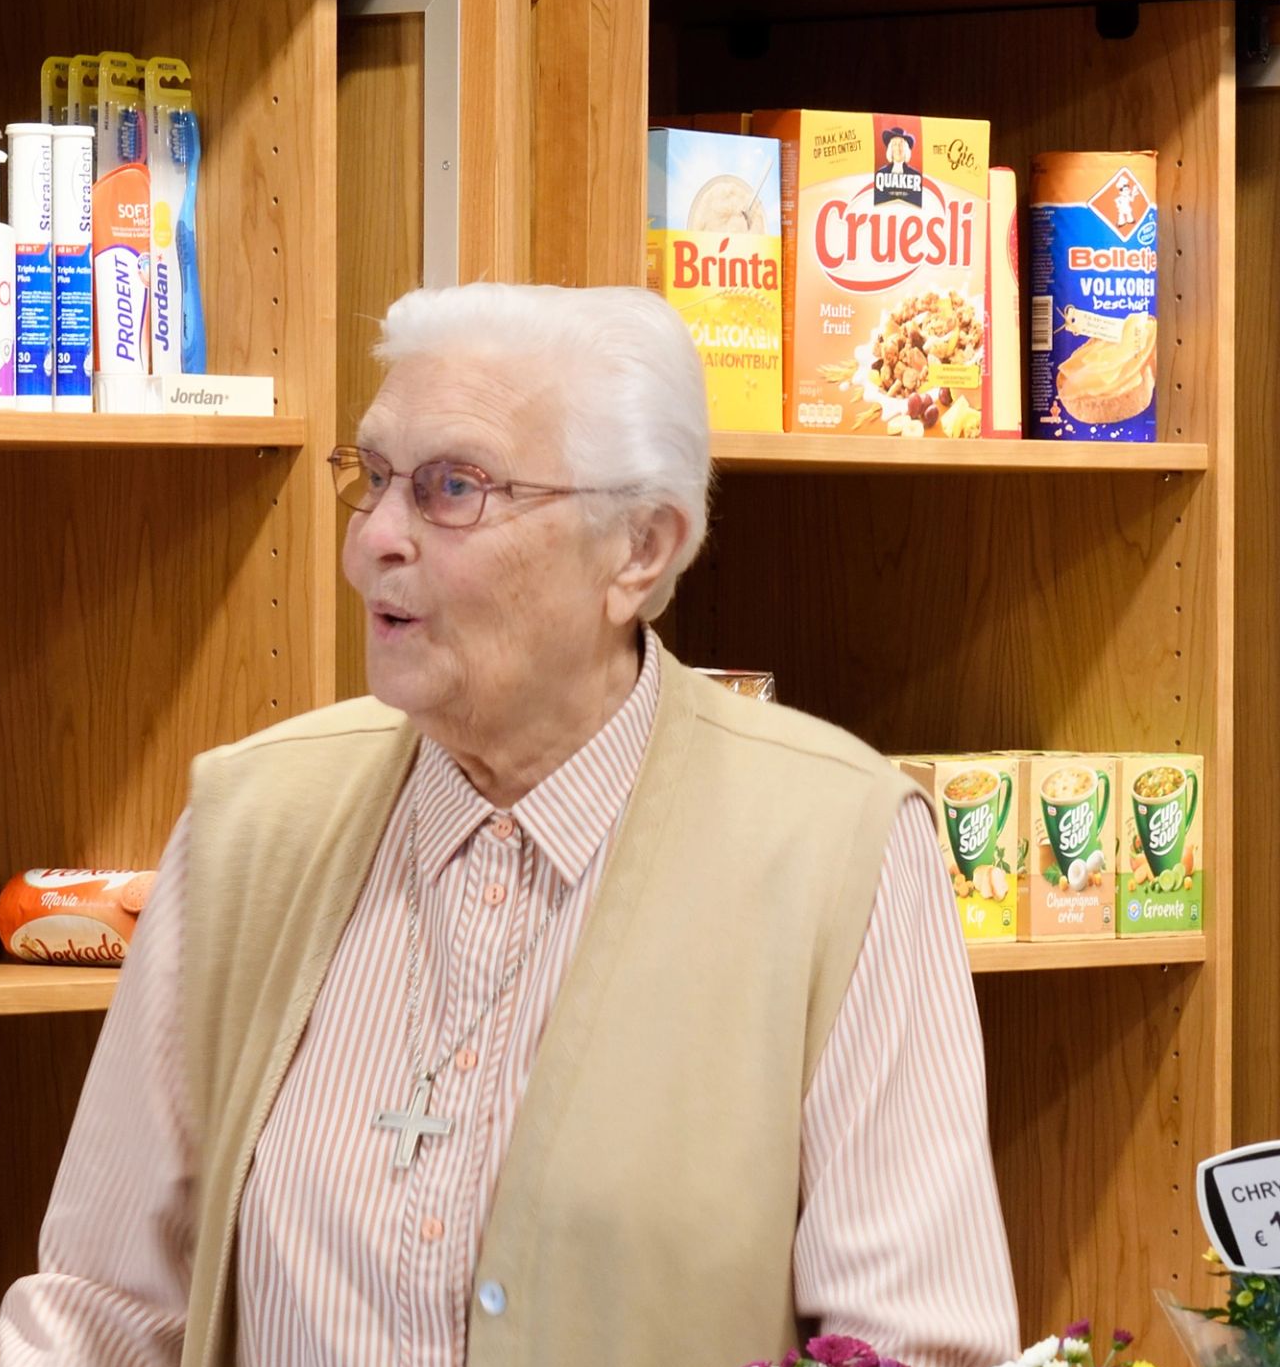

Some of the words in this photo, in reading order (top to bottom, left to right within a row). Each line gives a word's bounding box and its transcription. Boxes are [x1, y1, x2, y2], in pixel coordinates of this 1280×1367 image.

[813, 148, 822, 159] OP
[823, 143, 837, 158] EEN
[838, 140, 862, 154] ONTBIJT
[814, 133, 837, 147] MAAK
[838, 129, 857, 143] KANS
[39, 145, 51, 231] Steradent
[79, 146, 92, 232] Steradent
[875, 172, 922, 192] QUAKER
[118, 204, 149, 219] SOFT
[815, 200, 974, 271] Cruesli
[673, 237, 779, 291] Brinta
[1069, 247, 1158, 274] Bolletje
[115, 255, 135, 362] PRODENT
[155, 263, 170, 352] Jordan
[820, 304, 856, 319] Multi-
[1093, 295, 1150, 312] beschuit
[823, 319, 851, 335] fruit
[18, 352, 31, 363] 30
[58, 353, 71, 363] 30
[170, 388, 224, 406] Jordan
[959, 804, 990, 835] CUP
[1059, 801, 1090, 833] CUP
[1149, 800, 1179, 833] CUP
[1149, 809, 1184, 849] SOUP
[959, 813, 994, 853] SOUP
[1059, 810, 1095, 851] SOUP
[40, 891, 79, 909] Maria
[1046, 892, 1100, 913] Champignon
[1143, 898, 1185, 921] Groente
[966, 903, 986, 929] Kip
[20, 935, 124, 965] Verkade
[1253, 1227, 1269, 1248] €
